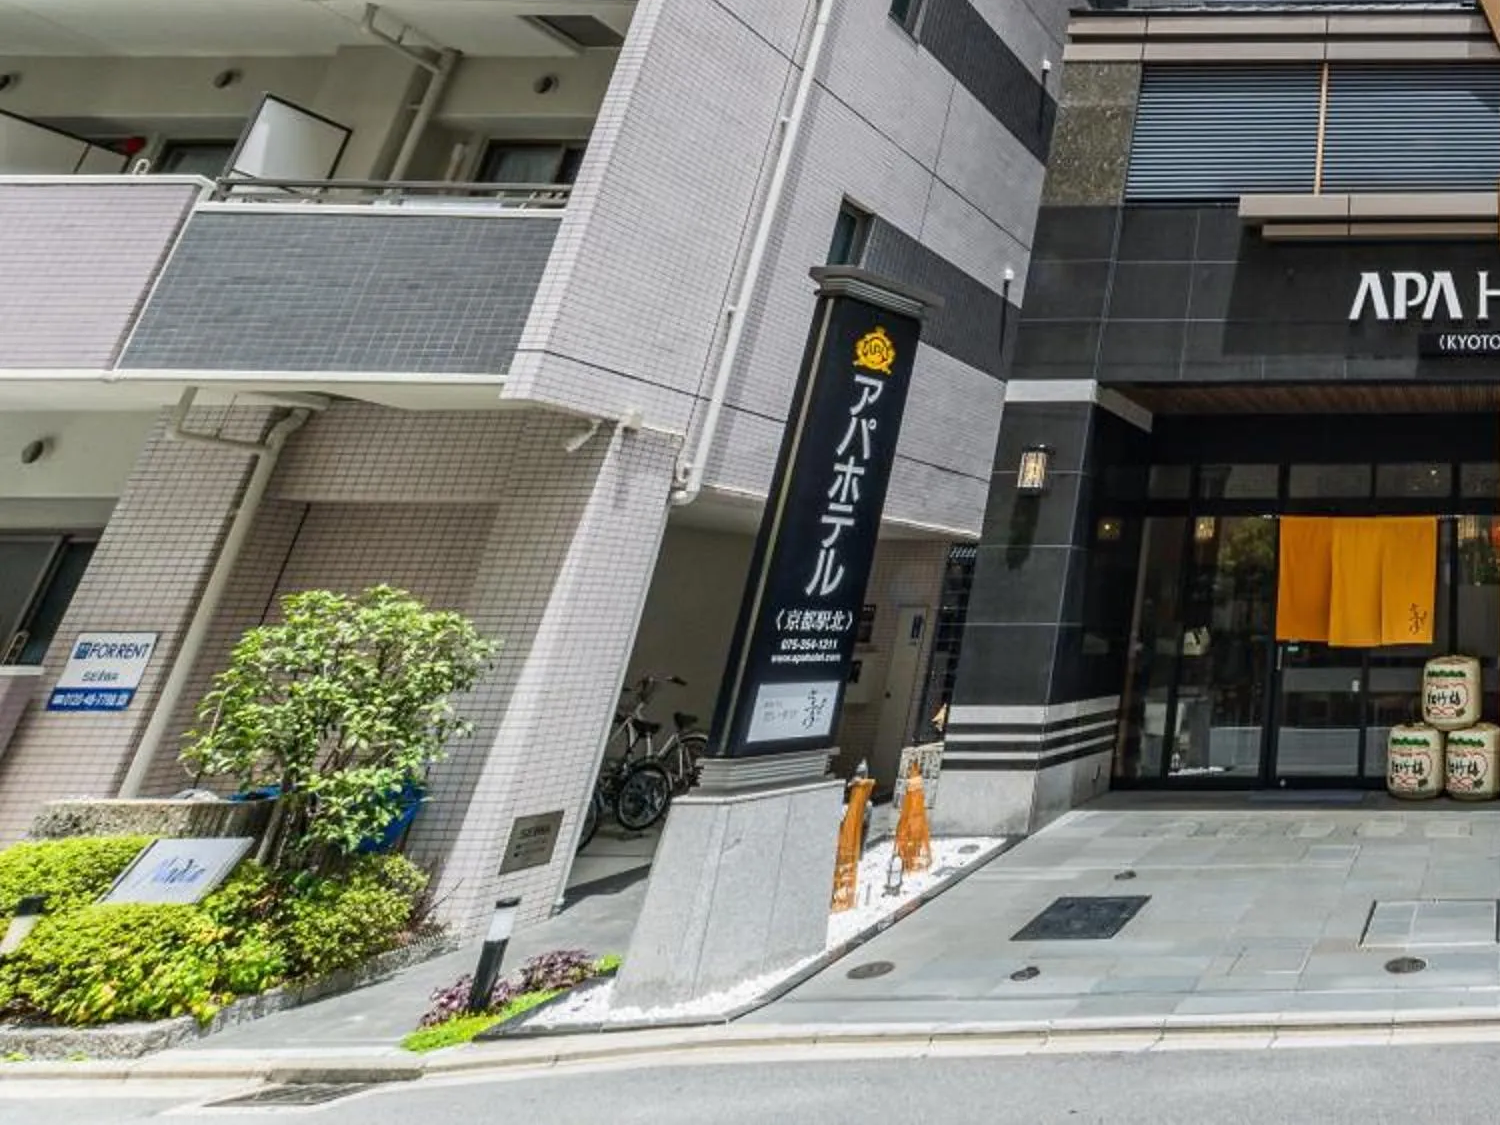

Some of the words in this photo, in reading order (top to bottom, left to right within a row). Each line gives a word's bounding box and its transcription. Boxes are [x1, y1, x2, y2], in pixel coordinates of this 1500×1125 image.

[1349, 271, 1463, 319] APA
[805, 375, 884, 596] アパホテル
